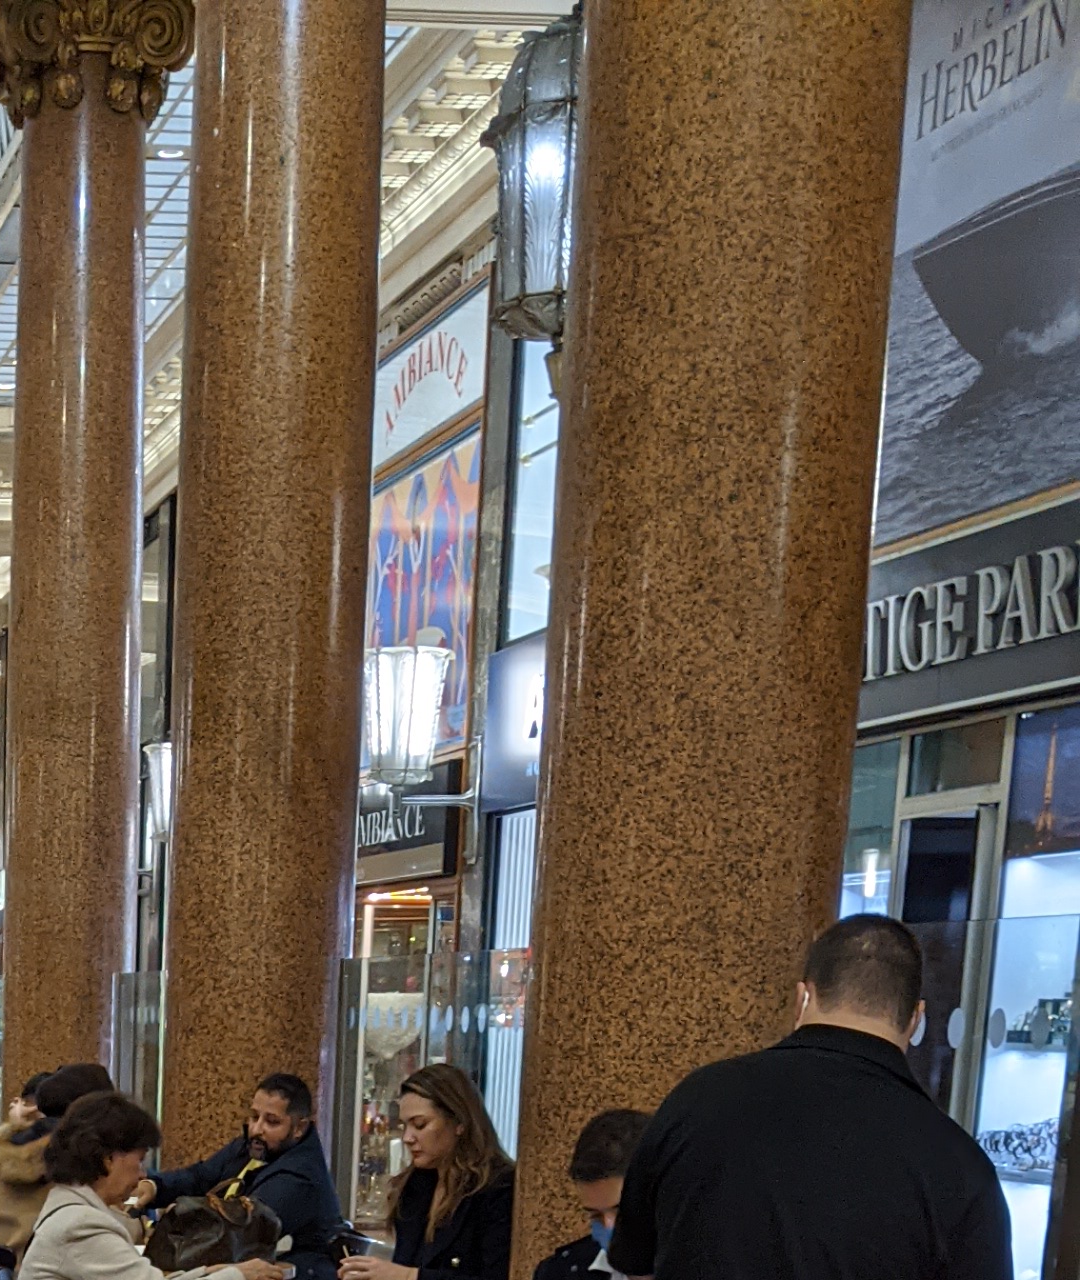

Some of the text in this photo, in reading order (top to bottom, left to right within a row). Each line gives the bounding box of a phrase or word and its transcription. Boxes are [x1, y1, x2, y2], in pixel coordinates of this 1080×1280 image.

[916, 0, 1069, 141] HERBELIN
[385, 331, 468, 446] AMBIANCE
[972, 539, 1080, 655] PAR
